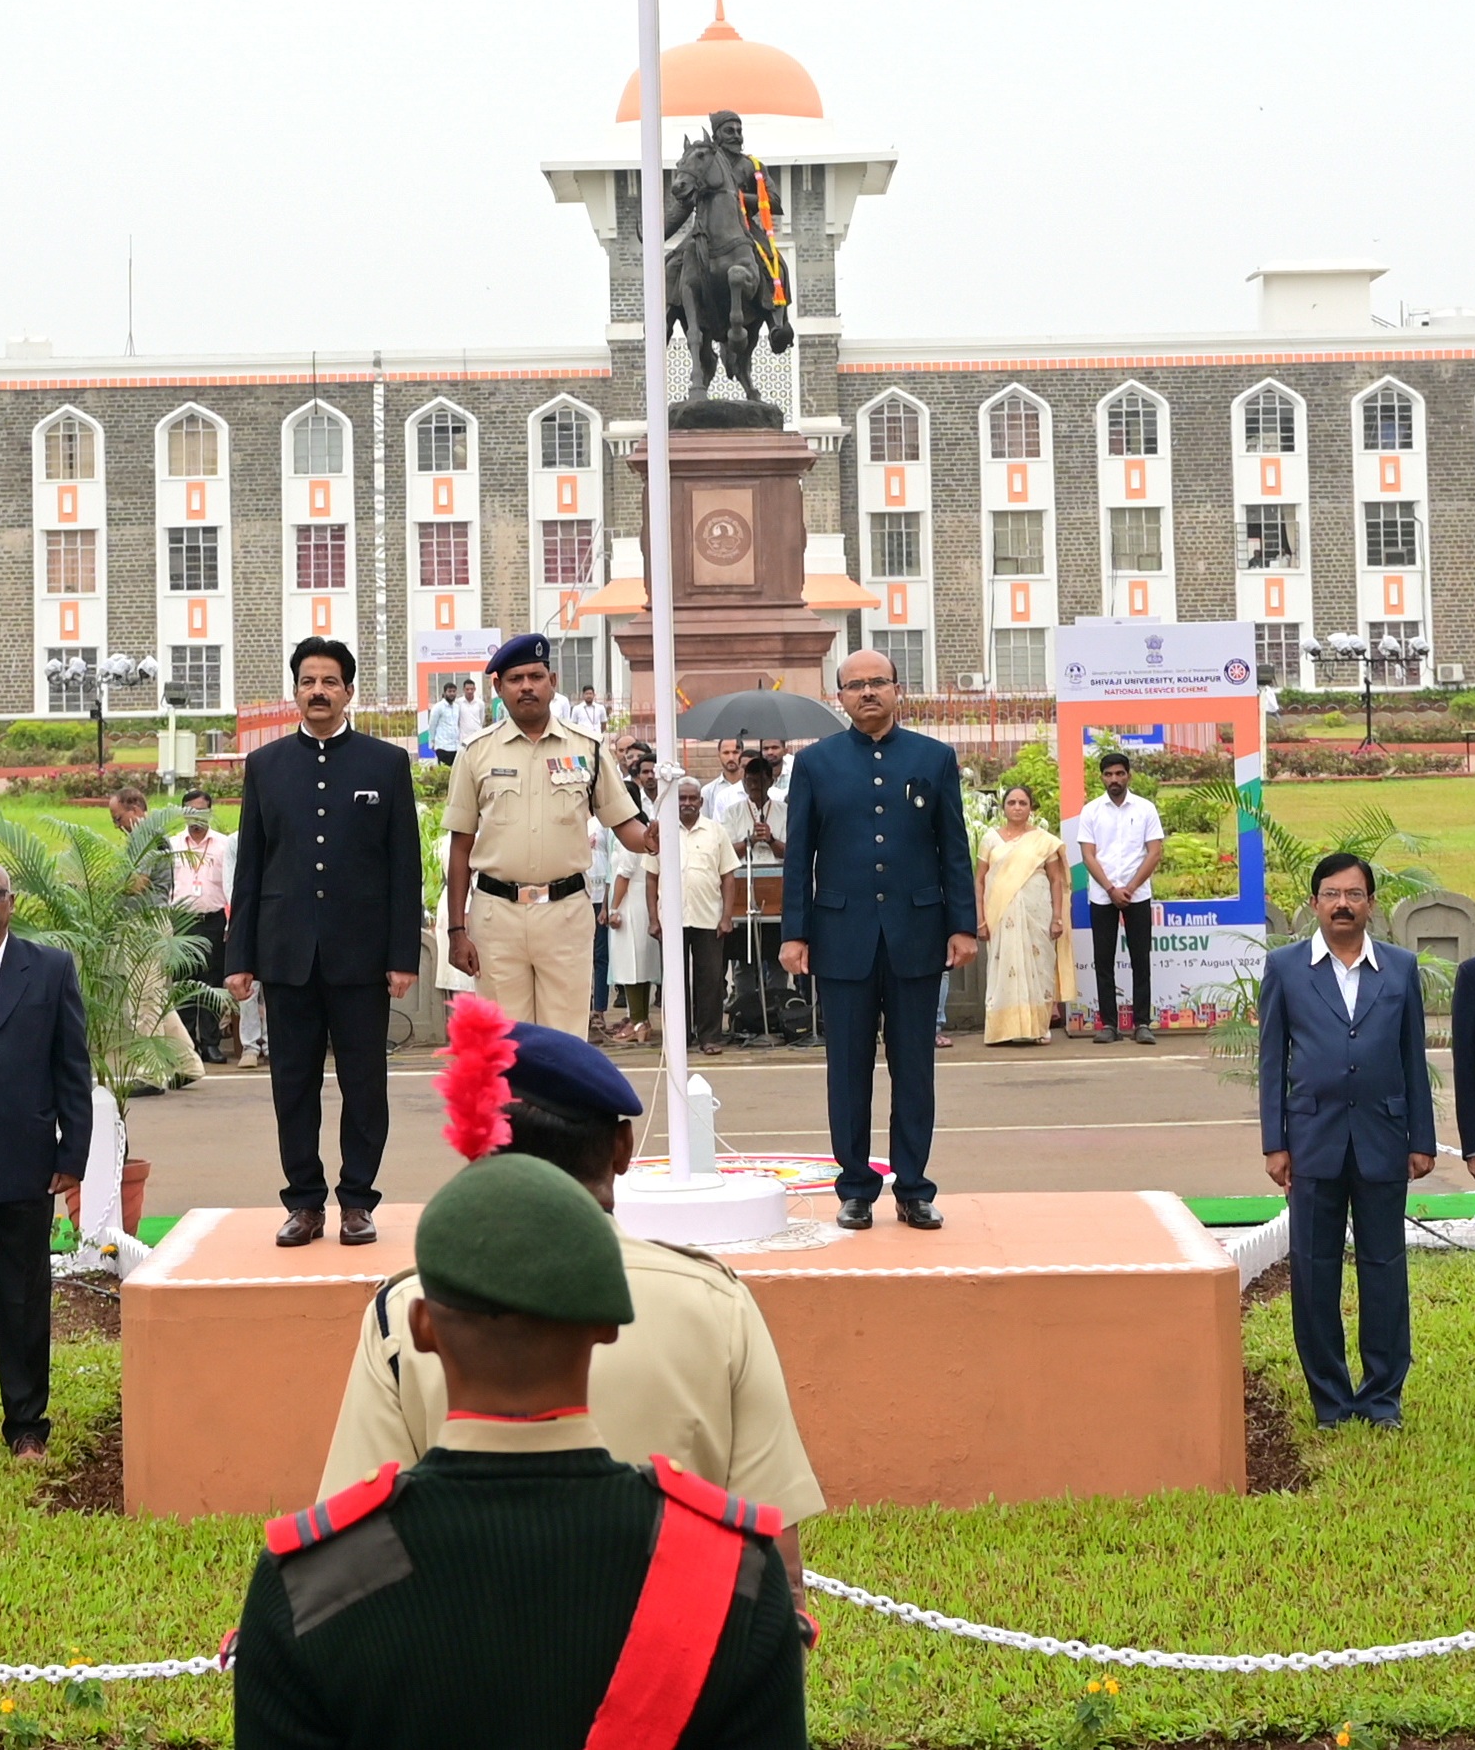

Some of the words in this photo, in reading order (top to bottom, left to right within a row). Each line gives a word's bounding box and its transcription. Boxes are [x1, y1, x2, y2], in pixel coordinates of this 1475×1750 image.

[1090, 678, 1122, 686] SHIVAJI
[1124, 677, 1175, 686] UNIVERSITY,
[1177, 675, 1222, 683] KOLHAPUR
[1167, 913, 1182, 926] Ka
[1185, 911, 1218, 926] Amrit
[1239, 957, 1261, 967] 2024
